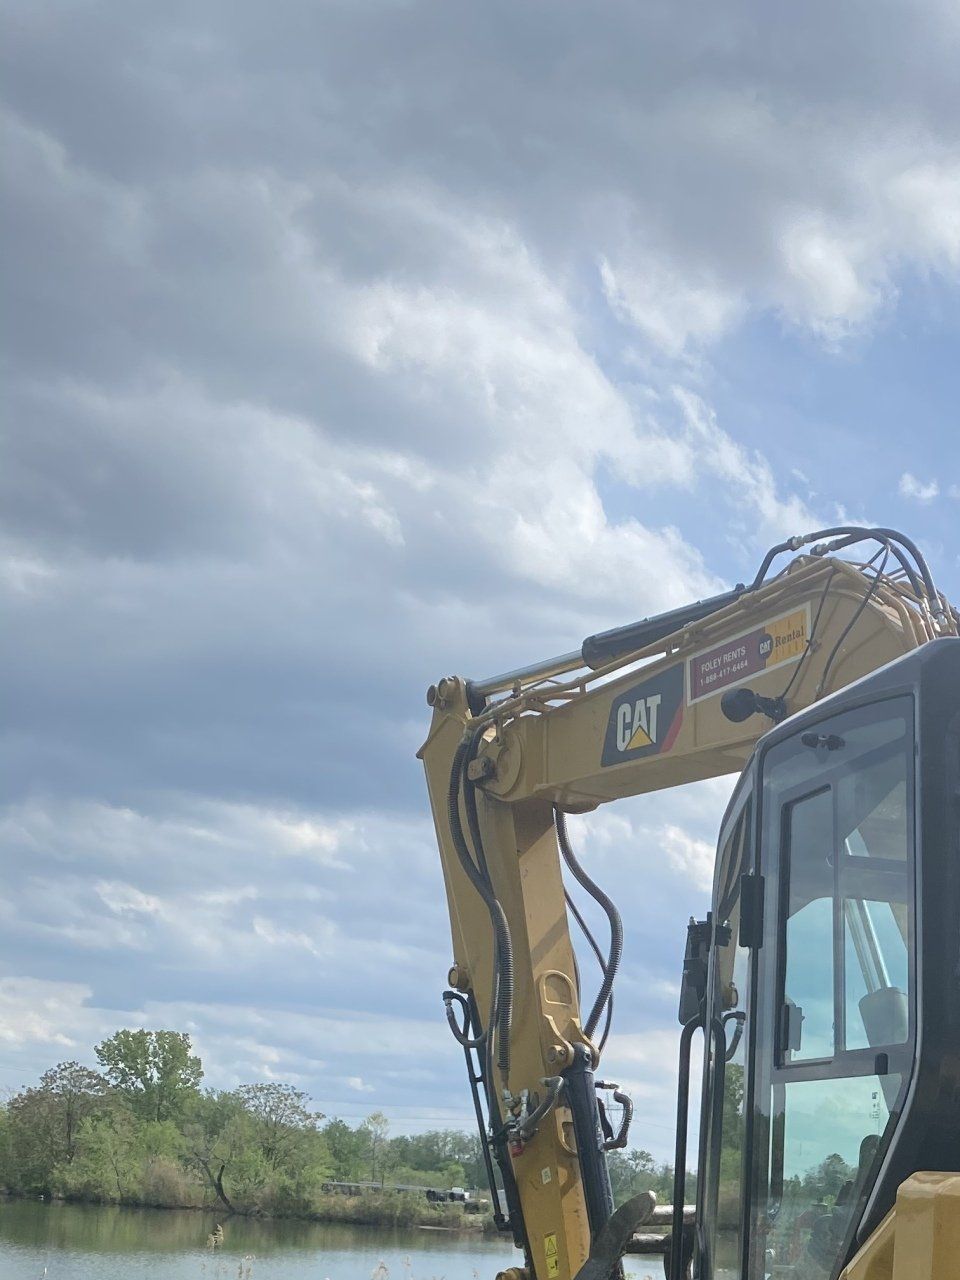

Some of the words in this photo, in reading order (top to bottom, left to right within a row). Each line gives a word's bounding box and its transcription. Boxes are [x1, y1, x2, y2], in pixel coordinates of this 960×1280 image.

[760, 640, 771, 655] CAT
[775, 626, 804, 648] Rental
[701, 657, 721, 673] FOLEY
[723, 646, 746, 663] RENTS
[616, 694, 661, 752] CAT
